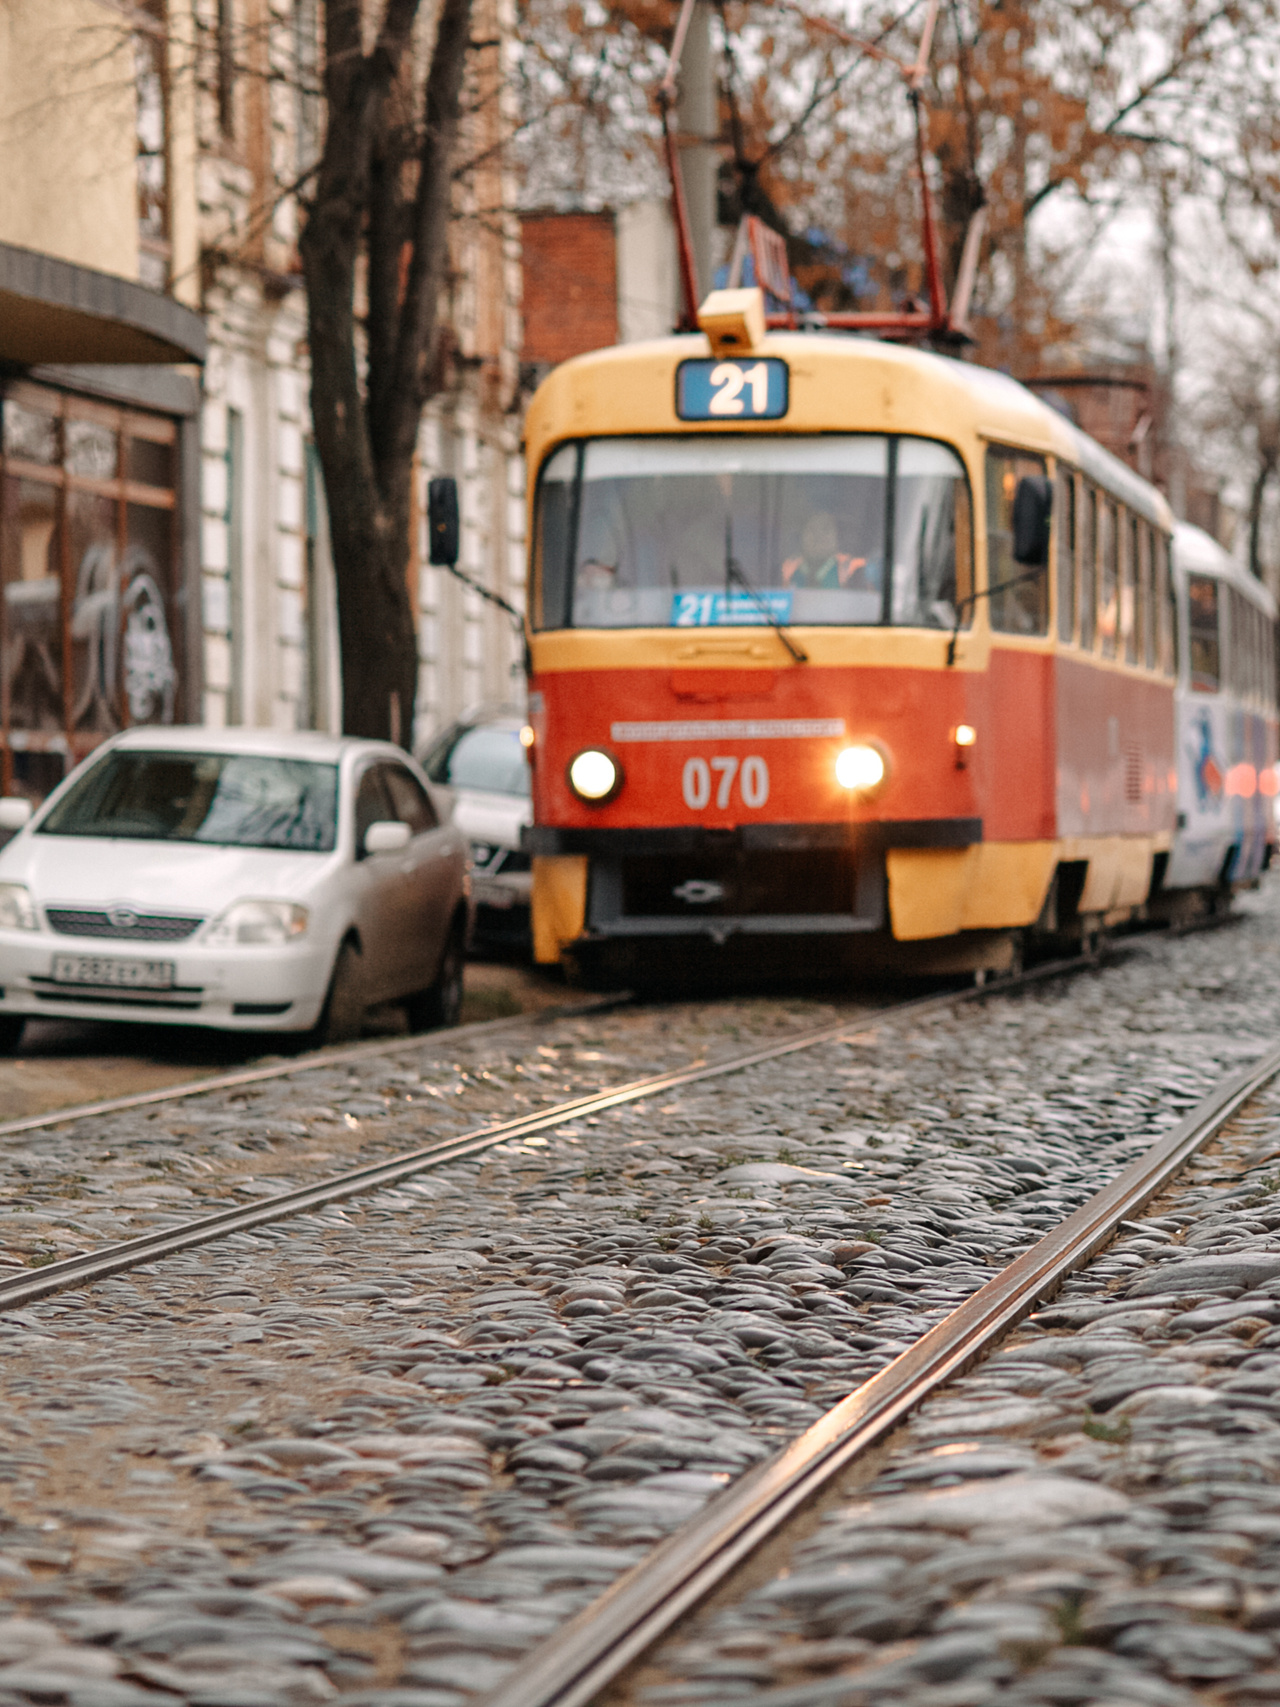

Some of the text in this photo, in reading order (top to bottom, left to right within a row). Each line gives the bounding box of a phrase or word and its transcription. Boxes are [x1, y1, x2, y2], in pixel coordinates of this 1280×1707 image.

[709, 362, 768, 415] 21
[678, 594, 714, 625] 21
[682, 756, 770, 810] 070
